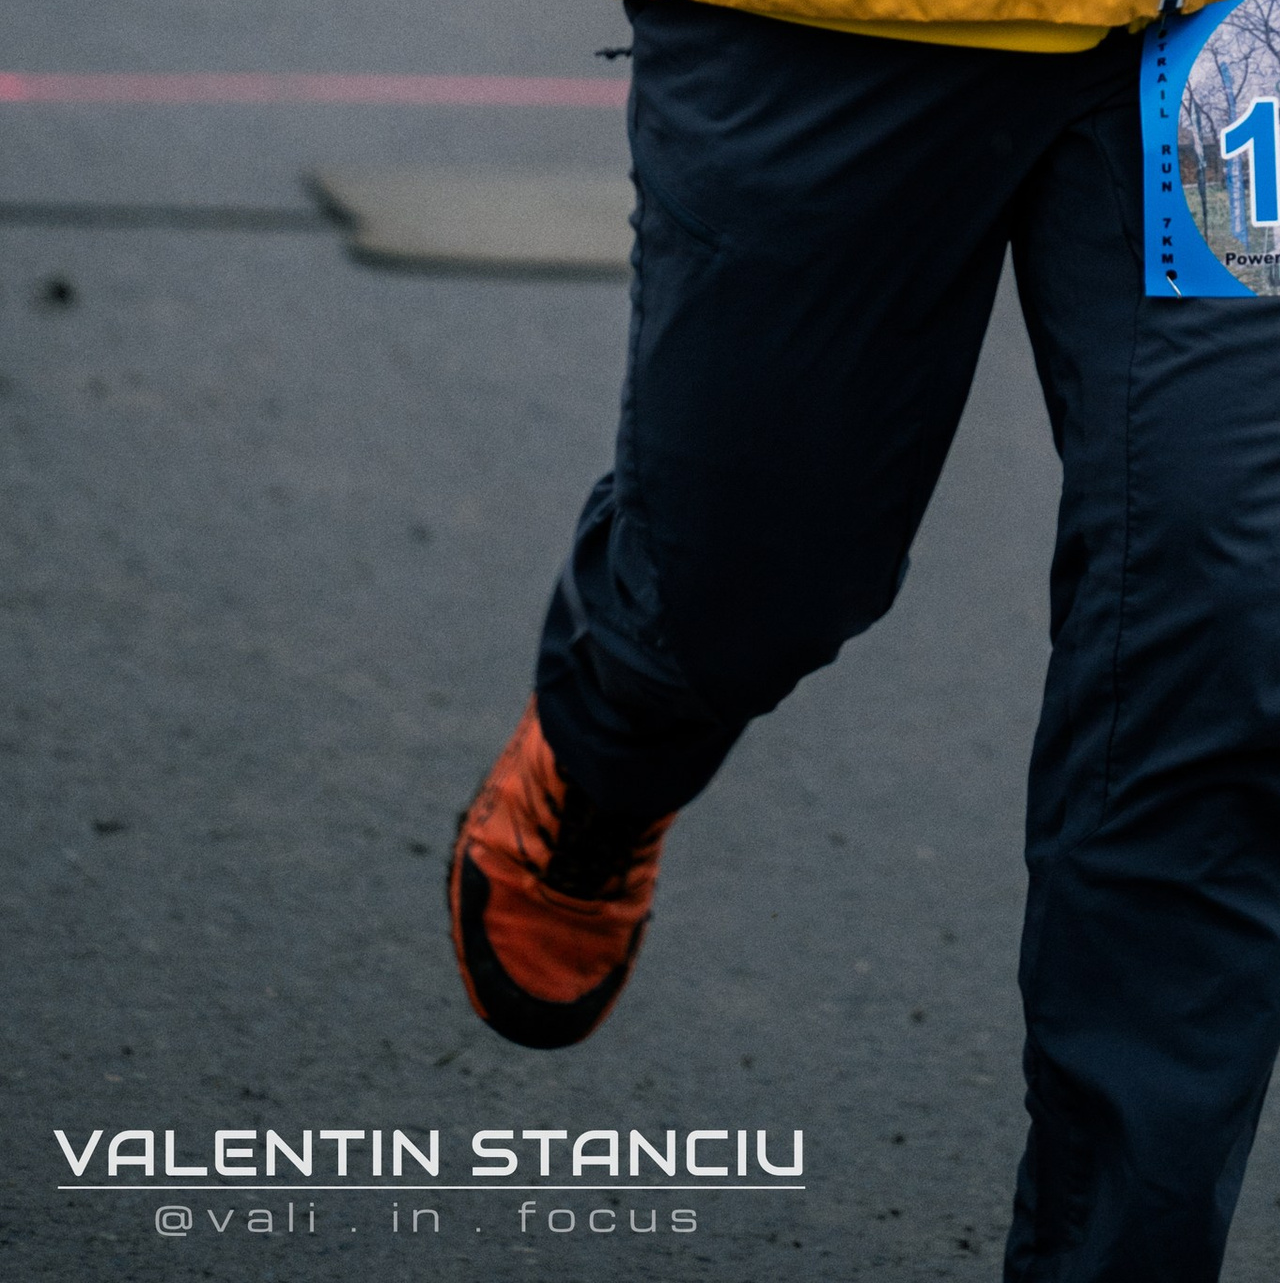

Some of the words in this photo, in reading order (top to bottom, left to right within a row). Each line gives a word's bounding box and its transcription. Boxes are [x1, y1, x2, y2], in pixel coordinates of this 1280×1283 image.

[1157, 42, 1169, 119] TRAIL
[1161, 144, 1172, 192] RUN
[1161, 217, 1173, 264] 7KM
